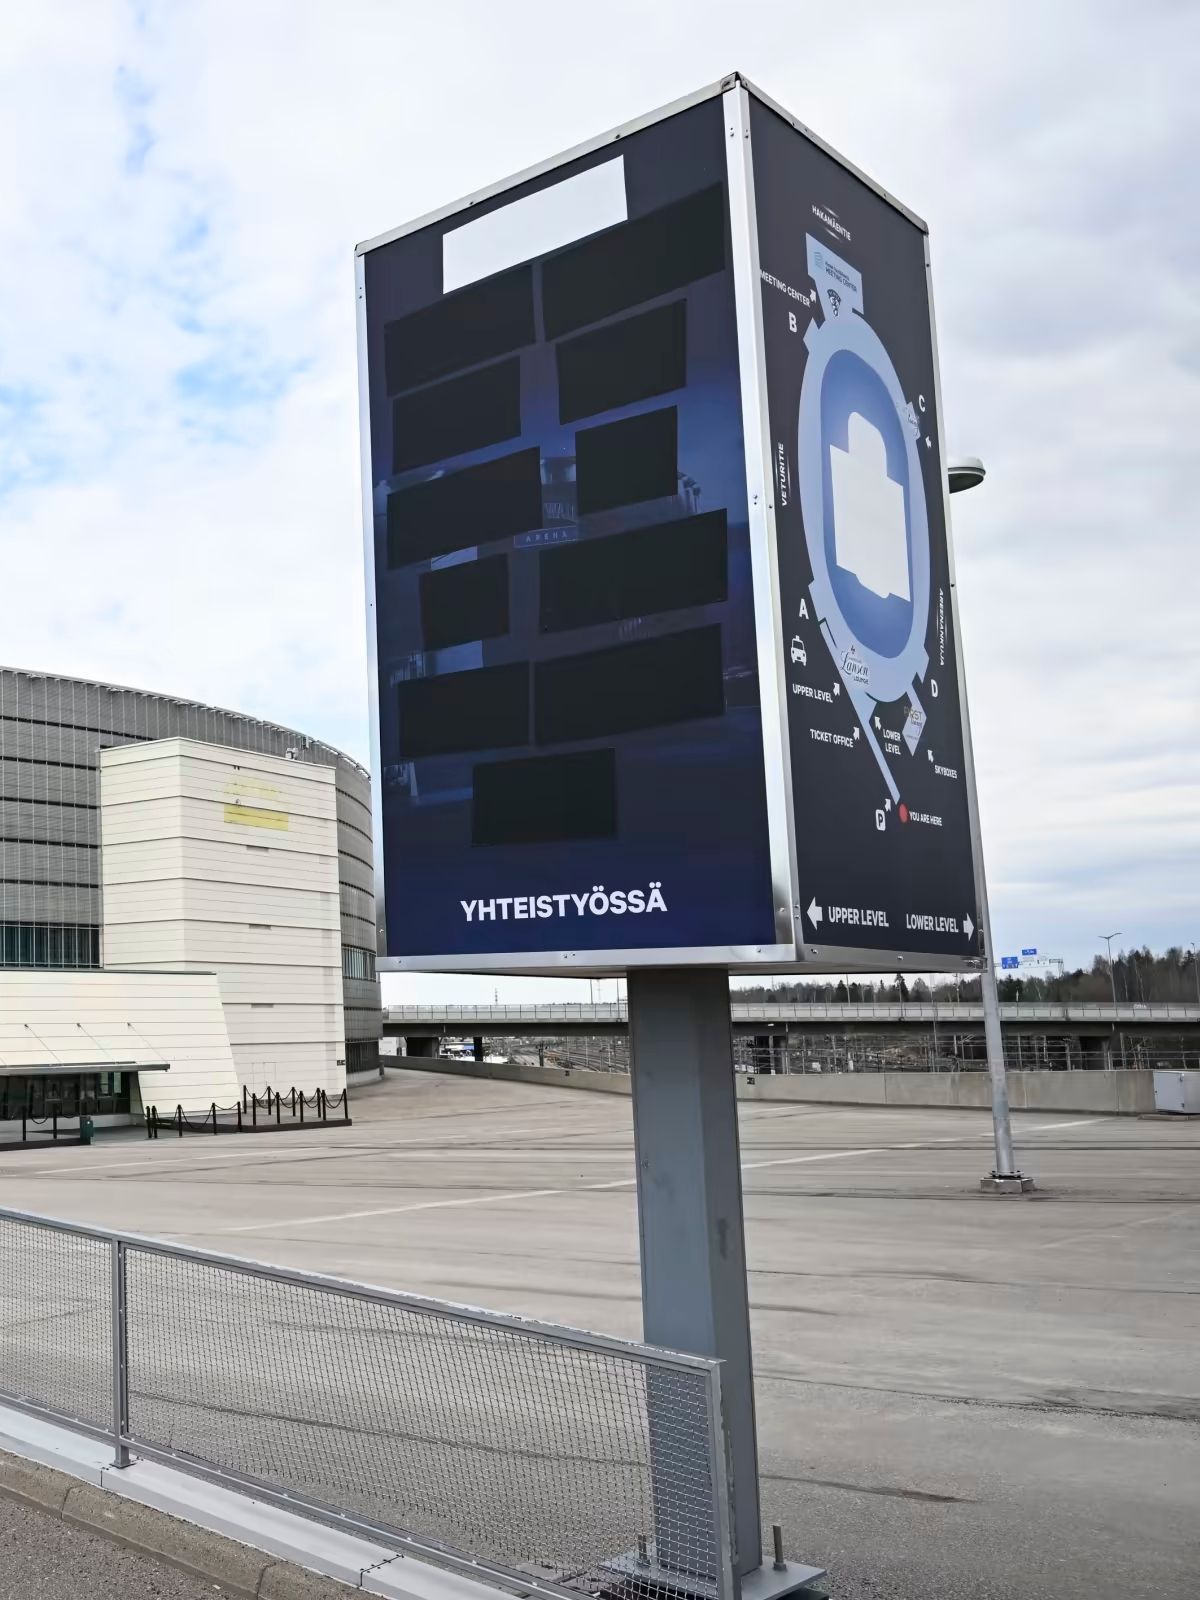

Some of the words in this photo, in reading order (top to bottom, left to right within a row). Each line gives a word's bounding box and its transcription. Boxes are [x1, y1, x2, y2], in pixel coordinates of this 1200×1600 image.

[812, 204, 852, 241] HAKAMÄENTIE
[760, 269, 787, 293] MEETING
[787, 286, 811, 308] CENTER
[788, 311, 798, 333] B
[918, 394, 926, 413] C
[778, 442, 788, 507] VETURITIE
[798, 598, 809, 620] A
[792, 683, 813, 698] UPPER
[813, 688, 834, 704] LEVEL
[930, 679, 939, 698] D
[809, 728, 832, 743] TICKET
[832, 734, 854, 748] OFFICE
[883, 728, 901, 742] LOWER
[885, 742, 902, 756] LEVEL
[934, 764, 958, 779] SKYBOXES
[909, 810, 920, 822] YOU
[920, 813, 930, 824] ARE
[930, 815, 943, 827] HERE
[460, 881, 668, 922] YHTEISTYÖSSÄ
[828, 905, 860, 926] UPPER
[860, 908, 890, 928] LEVEL
[906, 913, 934, 931] LOWER
[934, 916, 959, 933] LEVEL
